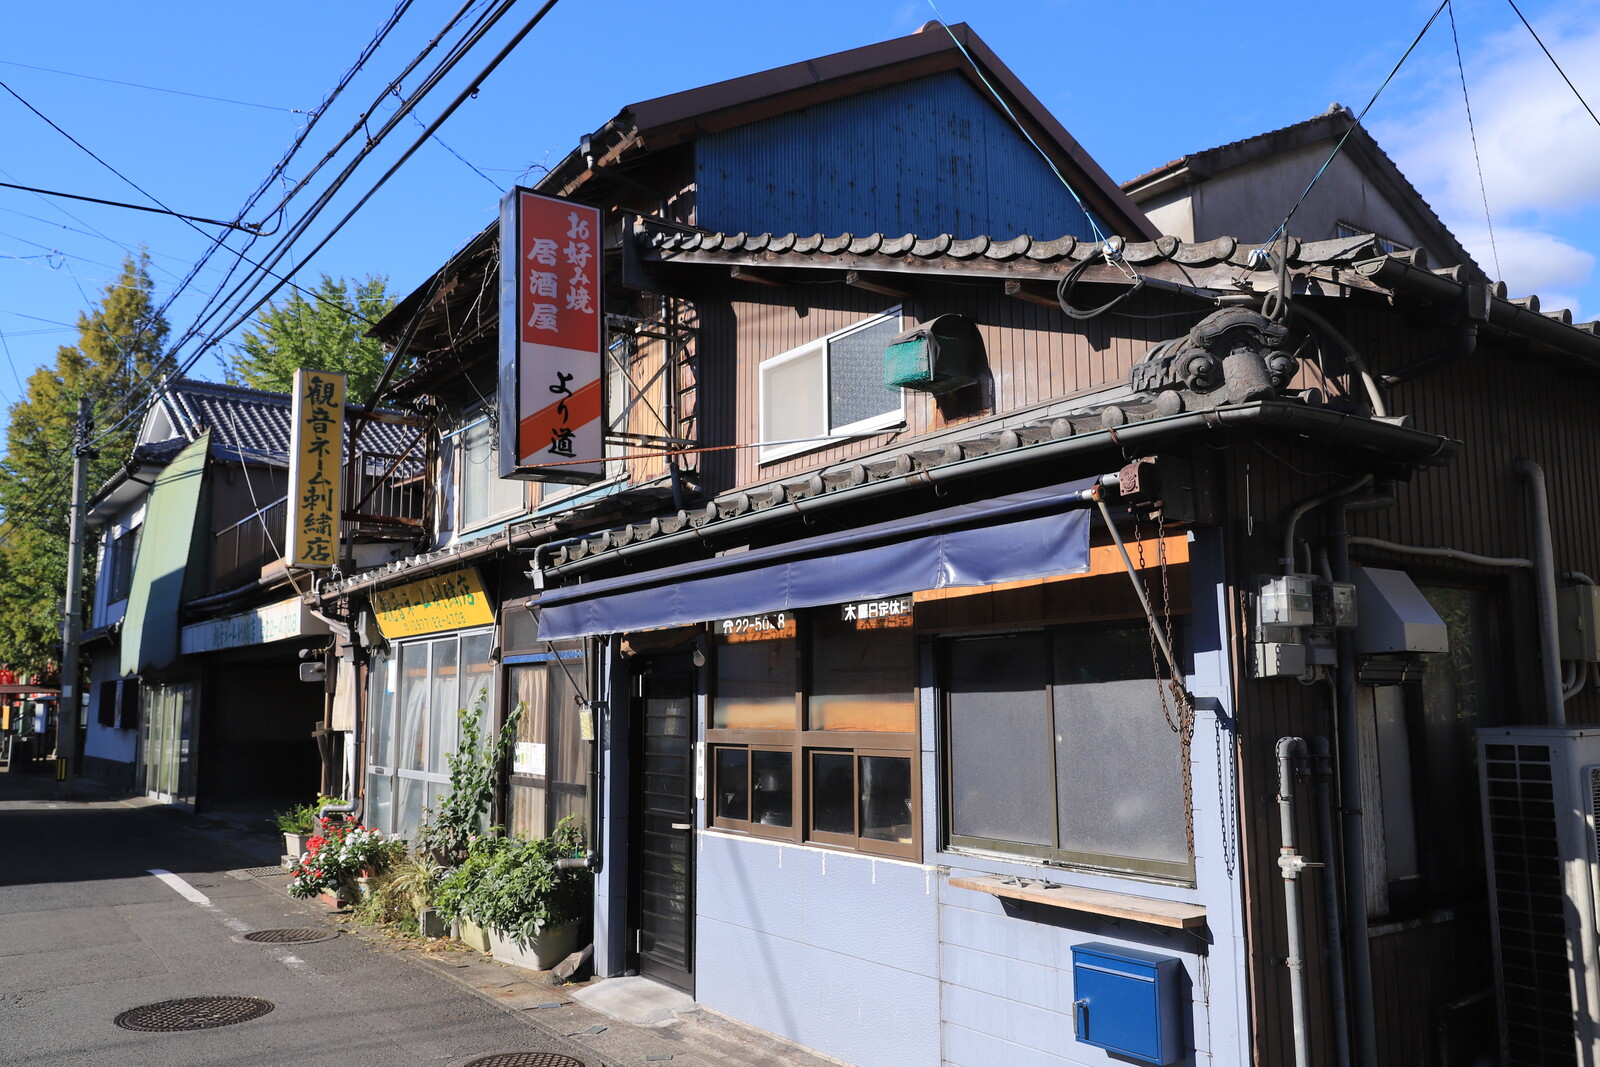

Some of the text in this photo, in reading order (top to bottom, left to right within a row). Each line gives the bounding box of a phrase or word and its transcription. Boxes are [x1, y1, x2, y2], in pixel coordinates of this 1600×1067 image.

[527, 237, 559, 333] 居酒屋
[563, 211, 594, 315] お好み焼
[548, 371, 576, 458] より道
[301, 376, 339, 562] 観音ネーム刺繍店
[735, 613, 785, 634] 22-508
[844, 599, 911, 622] 木曜日定休日
